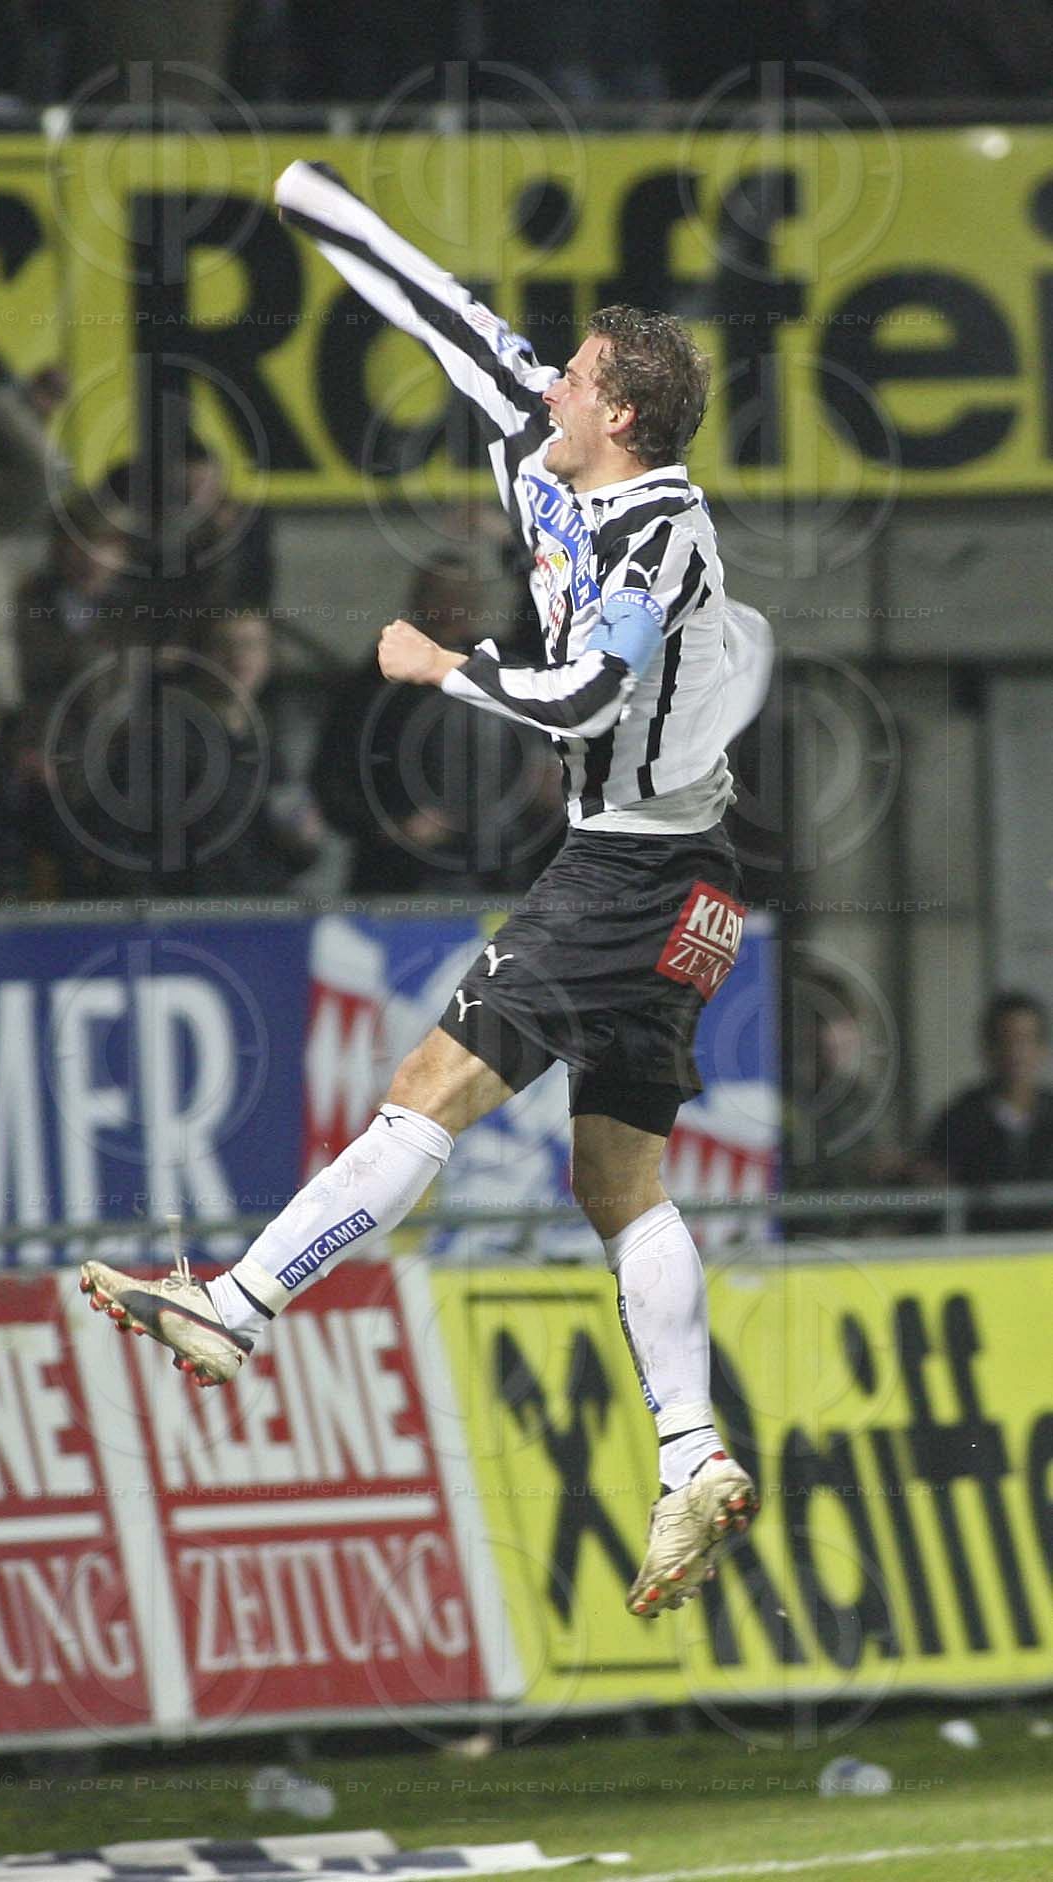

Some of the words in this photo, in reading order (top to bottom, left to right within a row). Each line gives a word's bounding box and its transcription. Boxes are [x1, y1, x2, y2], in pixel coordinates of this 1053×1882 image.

[279, 1213, 373, 1288] UNTIGAMER
[134, 1306, 428, 1490] KLEINE
[180, 1532, 469, 1671] ZEITUNG
